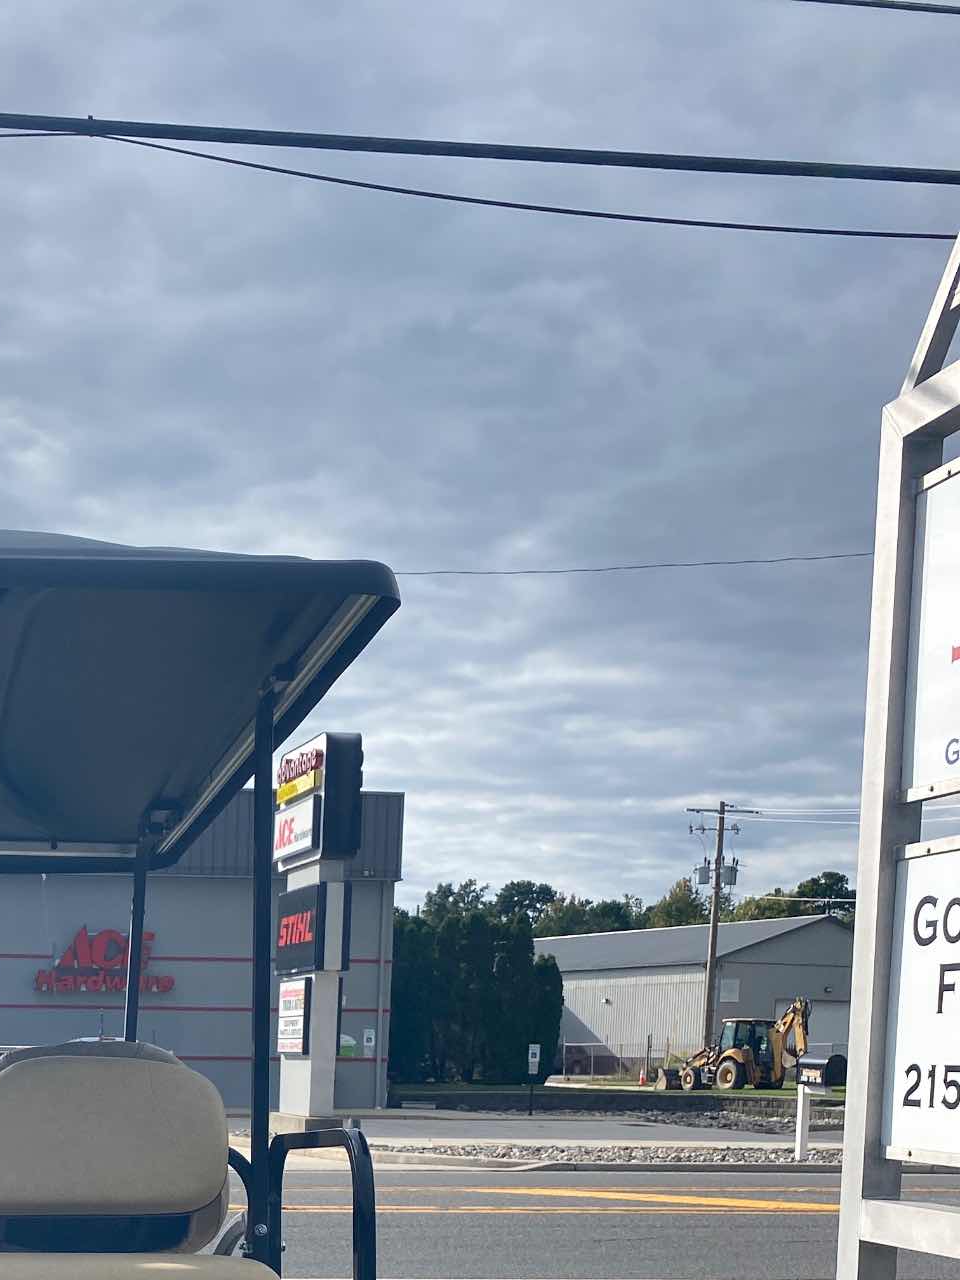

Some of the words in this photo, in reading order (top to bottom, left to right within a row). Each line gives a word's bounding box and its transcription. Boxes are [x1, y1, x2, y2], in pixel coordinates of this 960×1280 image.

[275, 817, 295, 850] ACE
[278, 911, 313, 947] STIHL
[903, 1064, 960, 1110] 215
